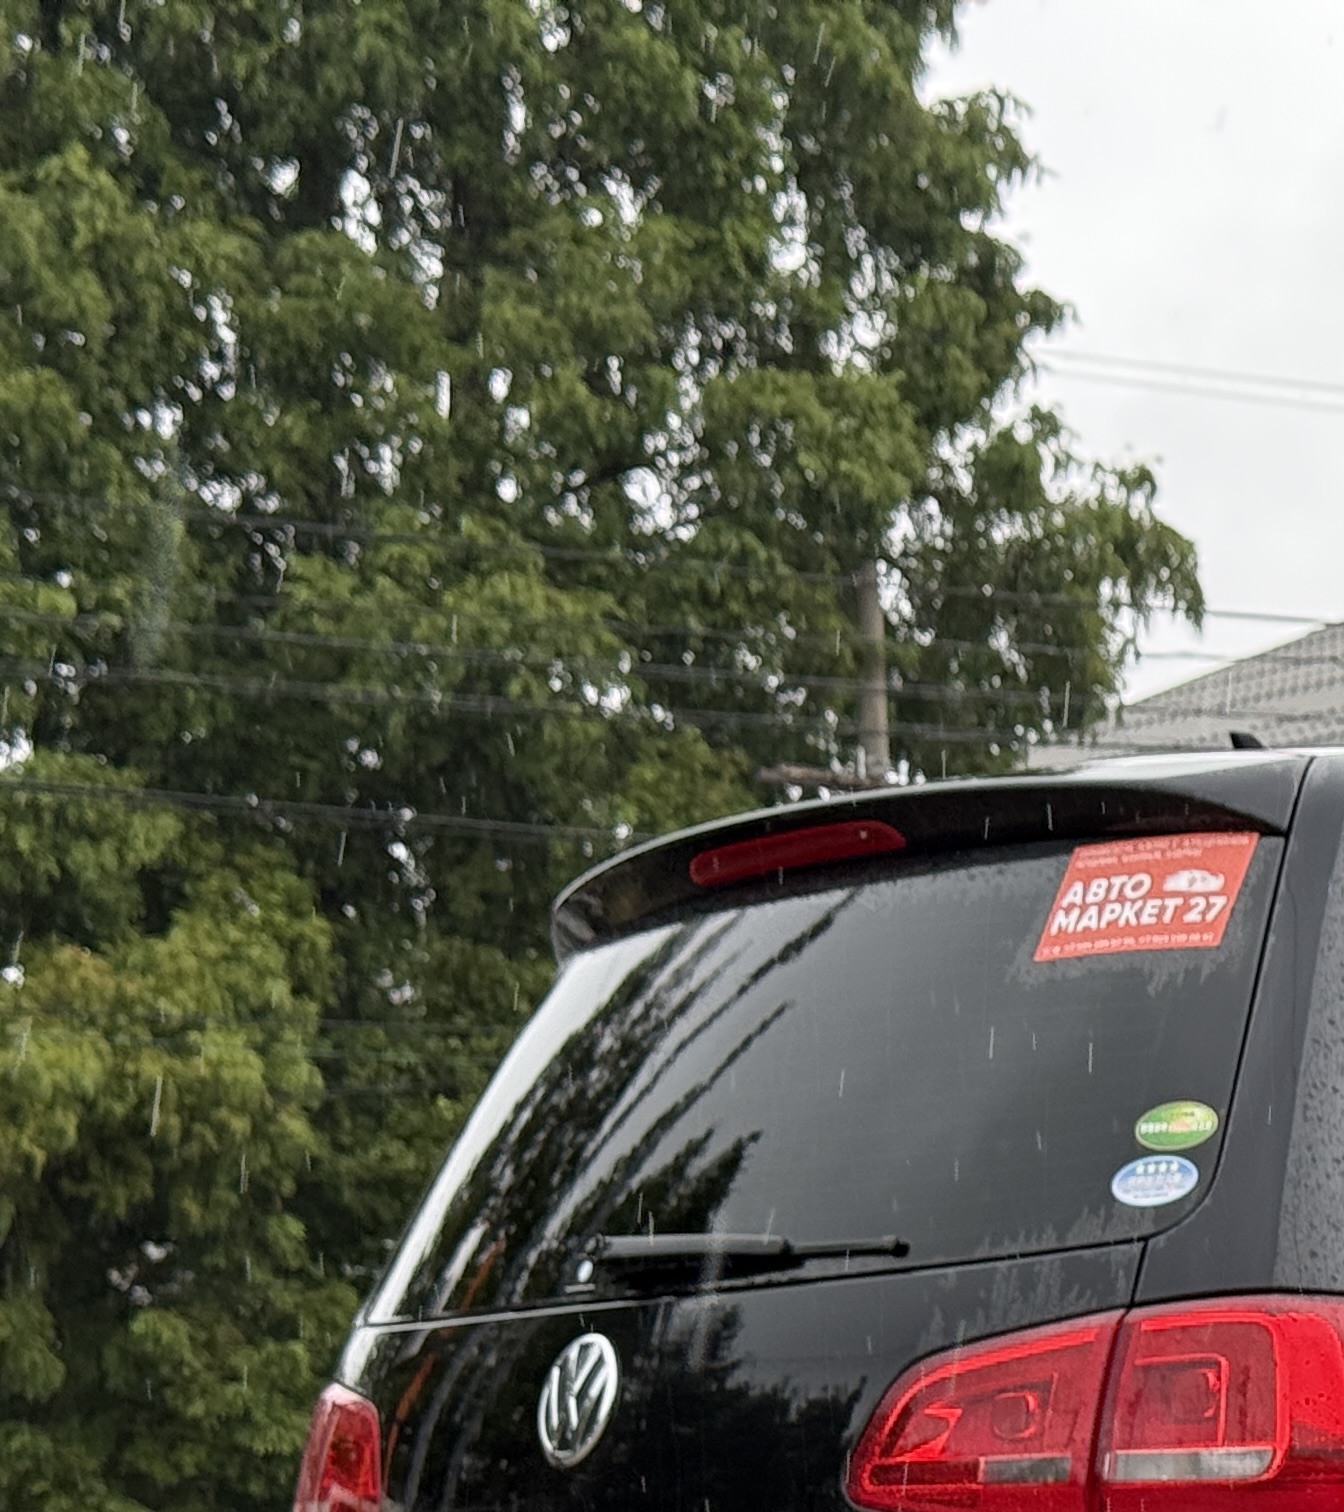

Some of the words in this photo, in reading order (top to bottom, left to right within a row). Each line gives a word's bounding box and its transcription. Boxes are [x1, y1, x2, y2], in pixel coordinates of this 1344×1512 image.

[1061, 872, 1152, 909] АВТО
[1049, 896, 1184, 937] МАРКЕТ
[1183, 895, 1229, 924] 27
[537, 1332, 619, 1467] VW
